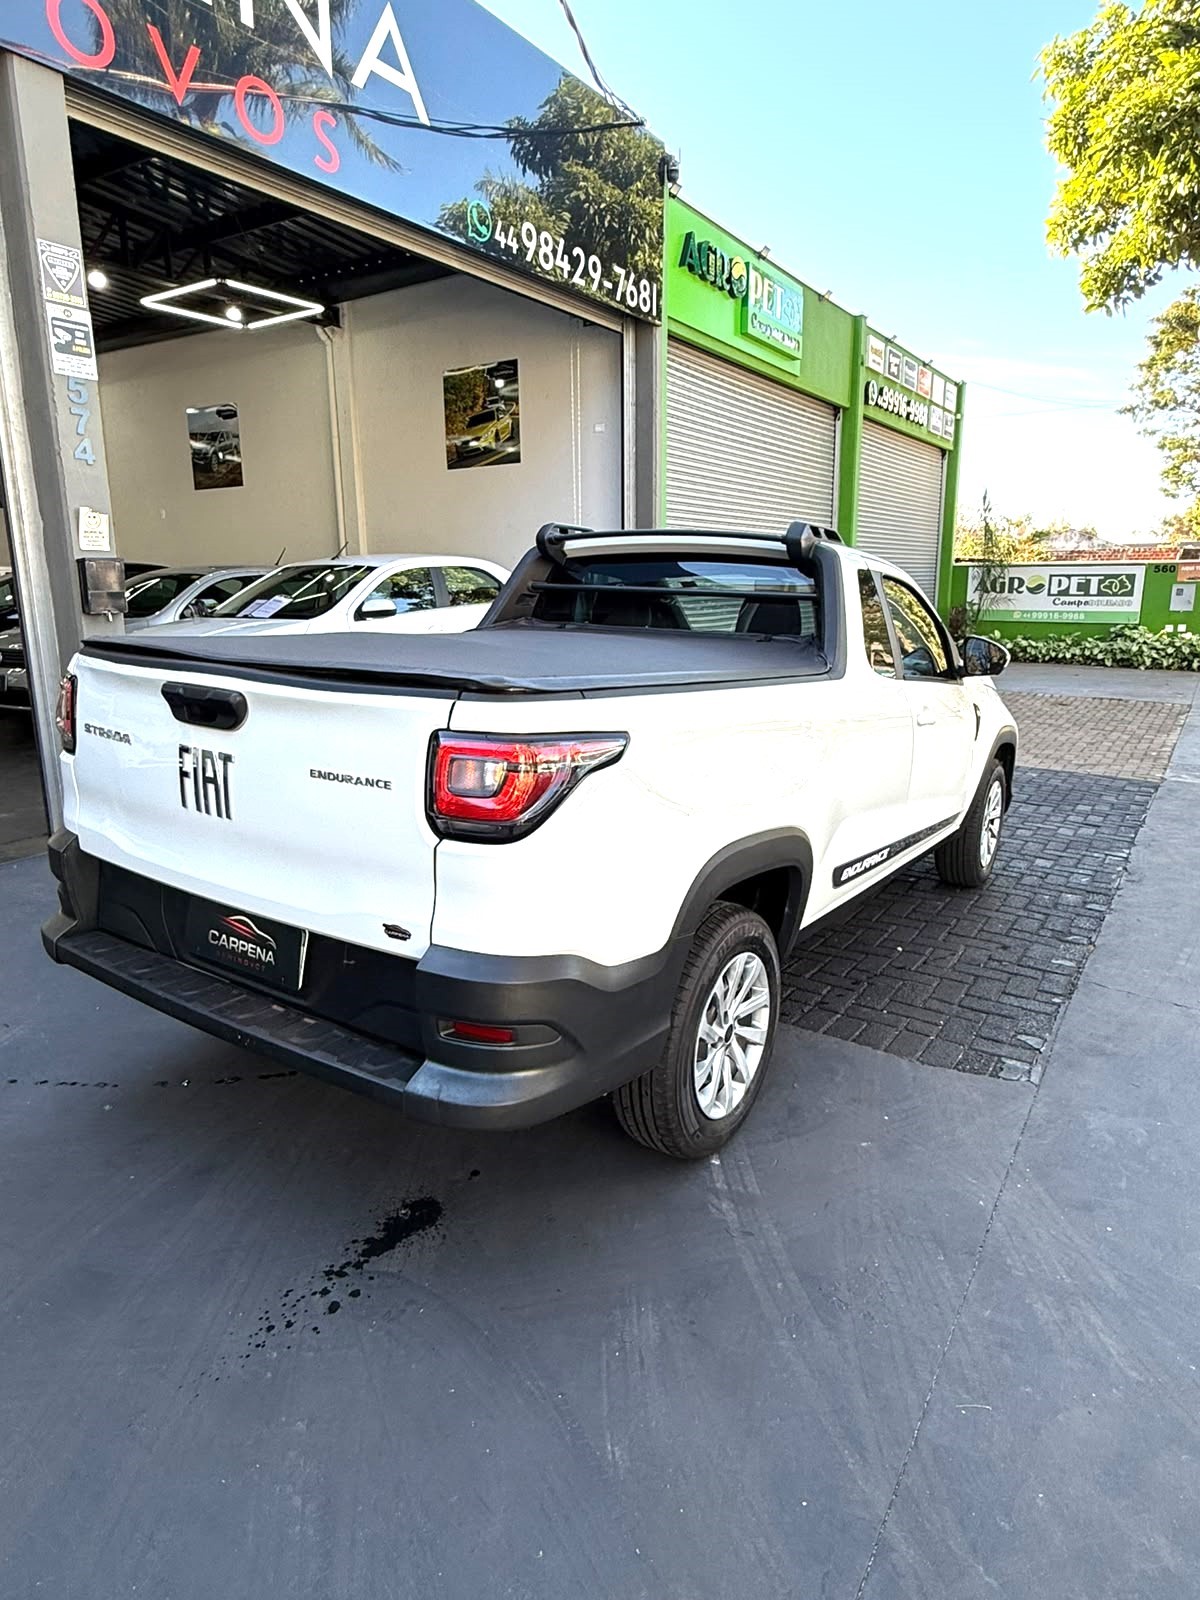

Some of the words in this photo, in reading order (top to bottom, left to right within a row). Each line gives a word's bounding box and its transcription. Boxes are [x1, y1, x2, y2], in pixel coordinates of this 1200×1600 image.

[521, 221, 657, 316] 98429-7681
[750, 267, 786, 321] PET
[1050, 575, 1105, 595] PET
[1154, 564, 1176, 574] 560
[178, 743, 236, 821] FIAT
[309, 768, 393, 791] ENDURANCE
[208, 929, 276, 967] CARPENA
